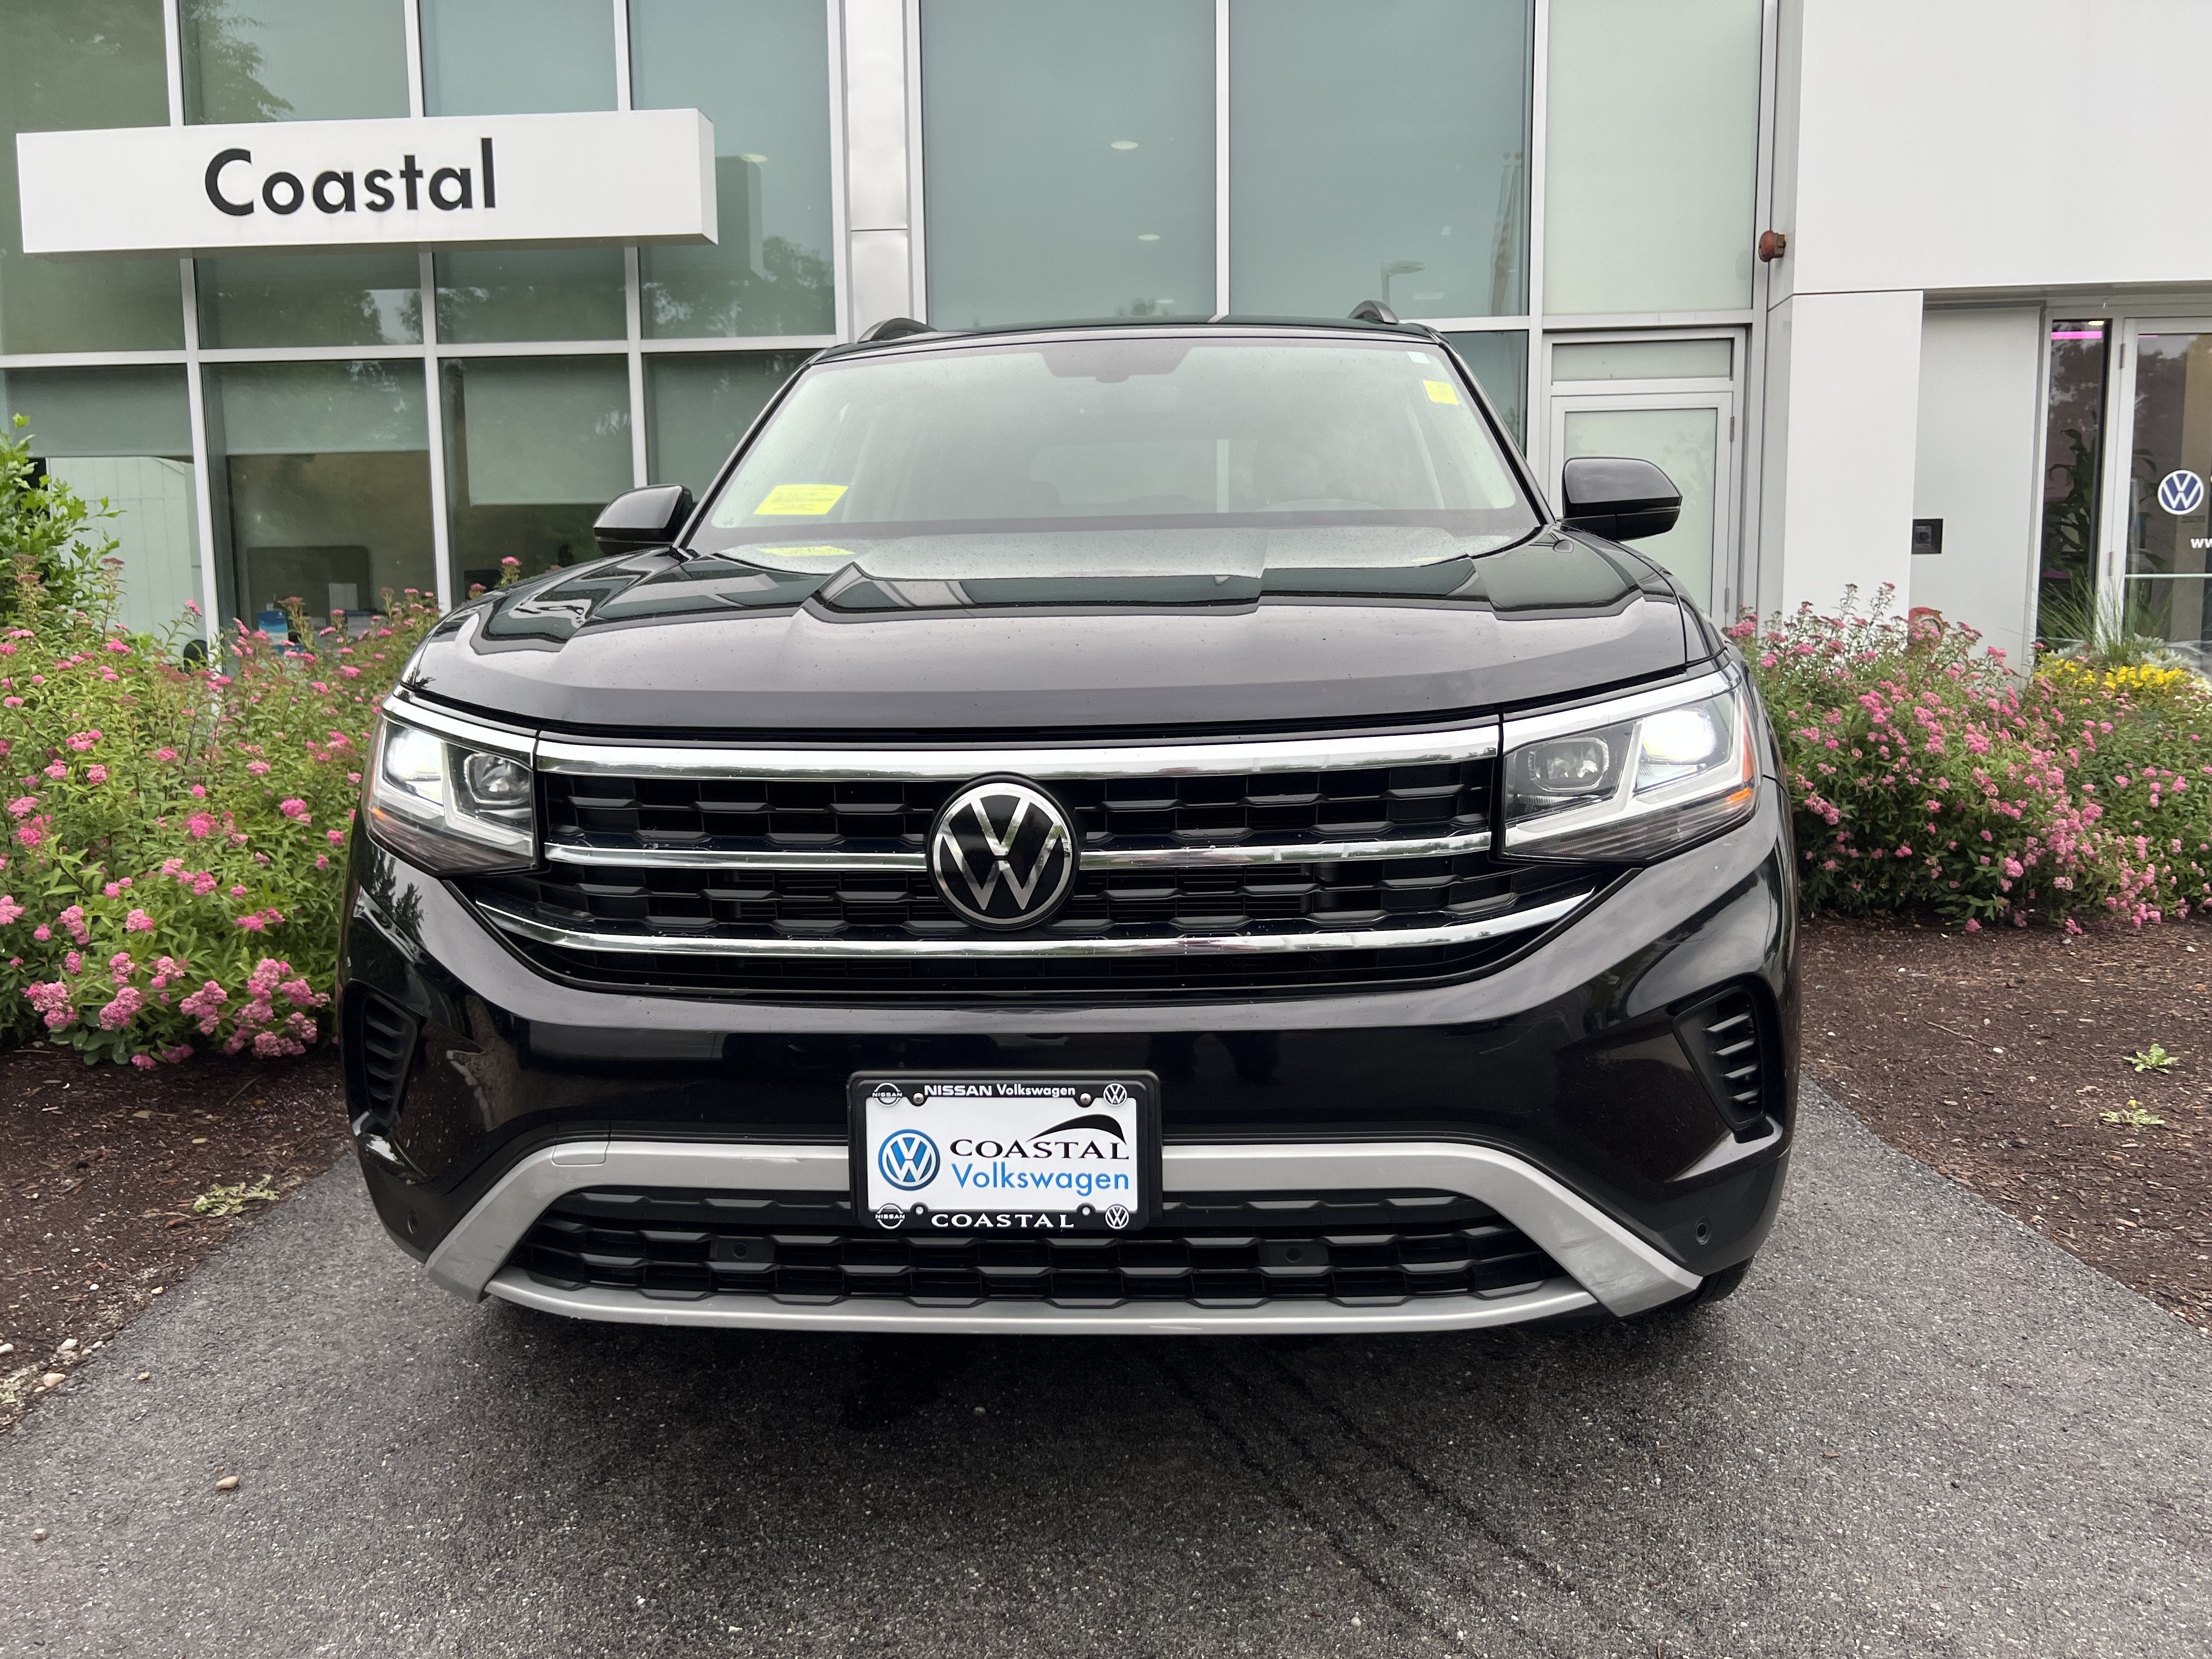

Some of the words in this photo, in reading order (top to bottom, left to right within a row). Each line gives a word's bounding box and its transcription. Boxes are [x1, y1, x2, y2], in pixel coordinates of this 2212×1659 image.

[205, 138, 495, 216] Coastal
[2159, 471, 2203, 514] VW
[935, 786, 1070, 923] VW
[924, 1085, 992, 1096] NISSAN
[996, 1084, 1076, 1098] Volkswagen
[880, 1130, 938, 1189] VW
[950, 1139, 1129, 1160] COASTAL
[951, 1162, 1129, 1197] Volkswagen
[931, 1214, 1074, 1227] COASTAL
